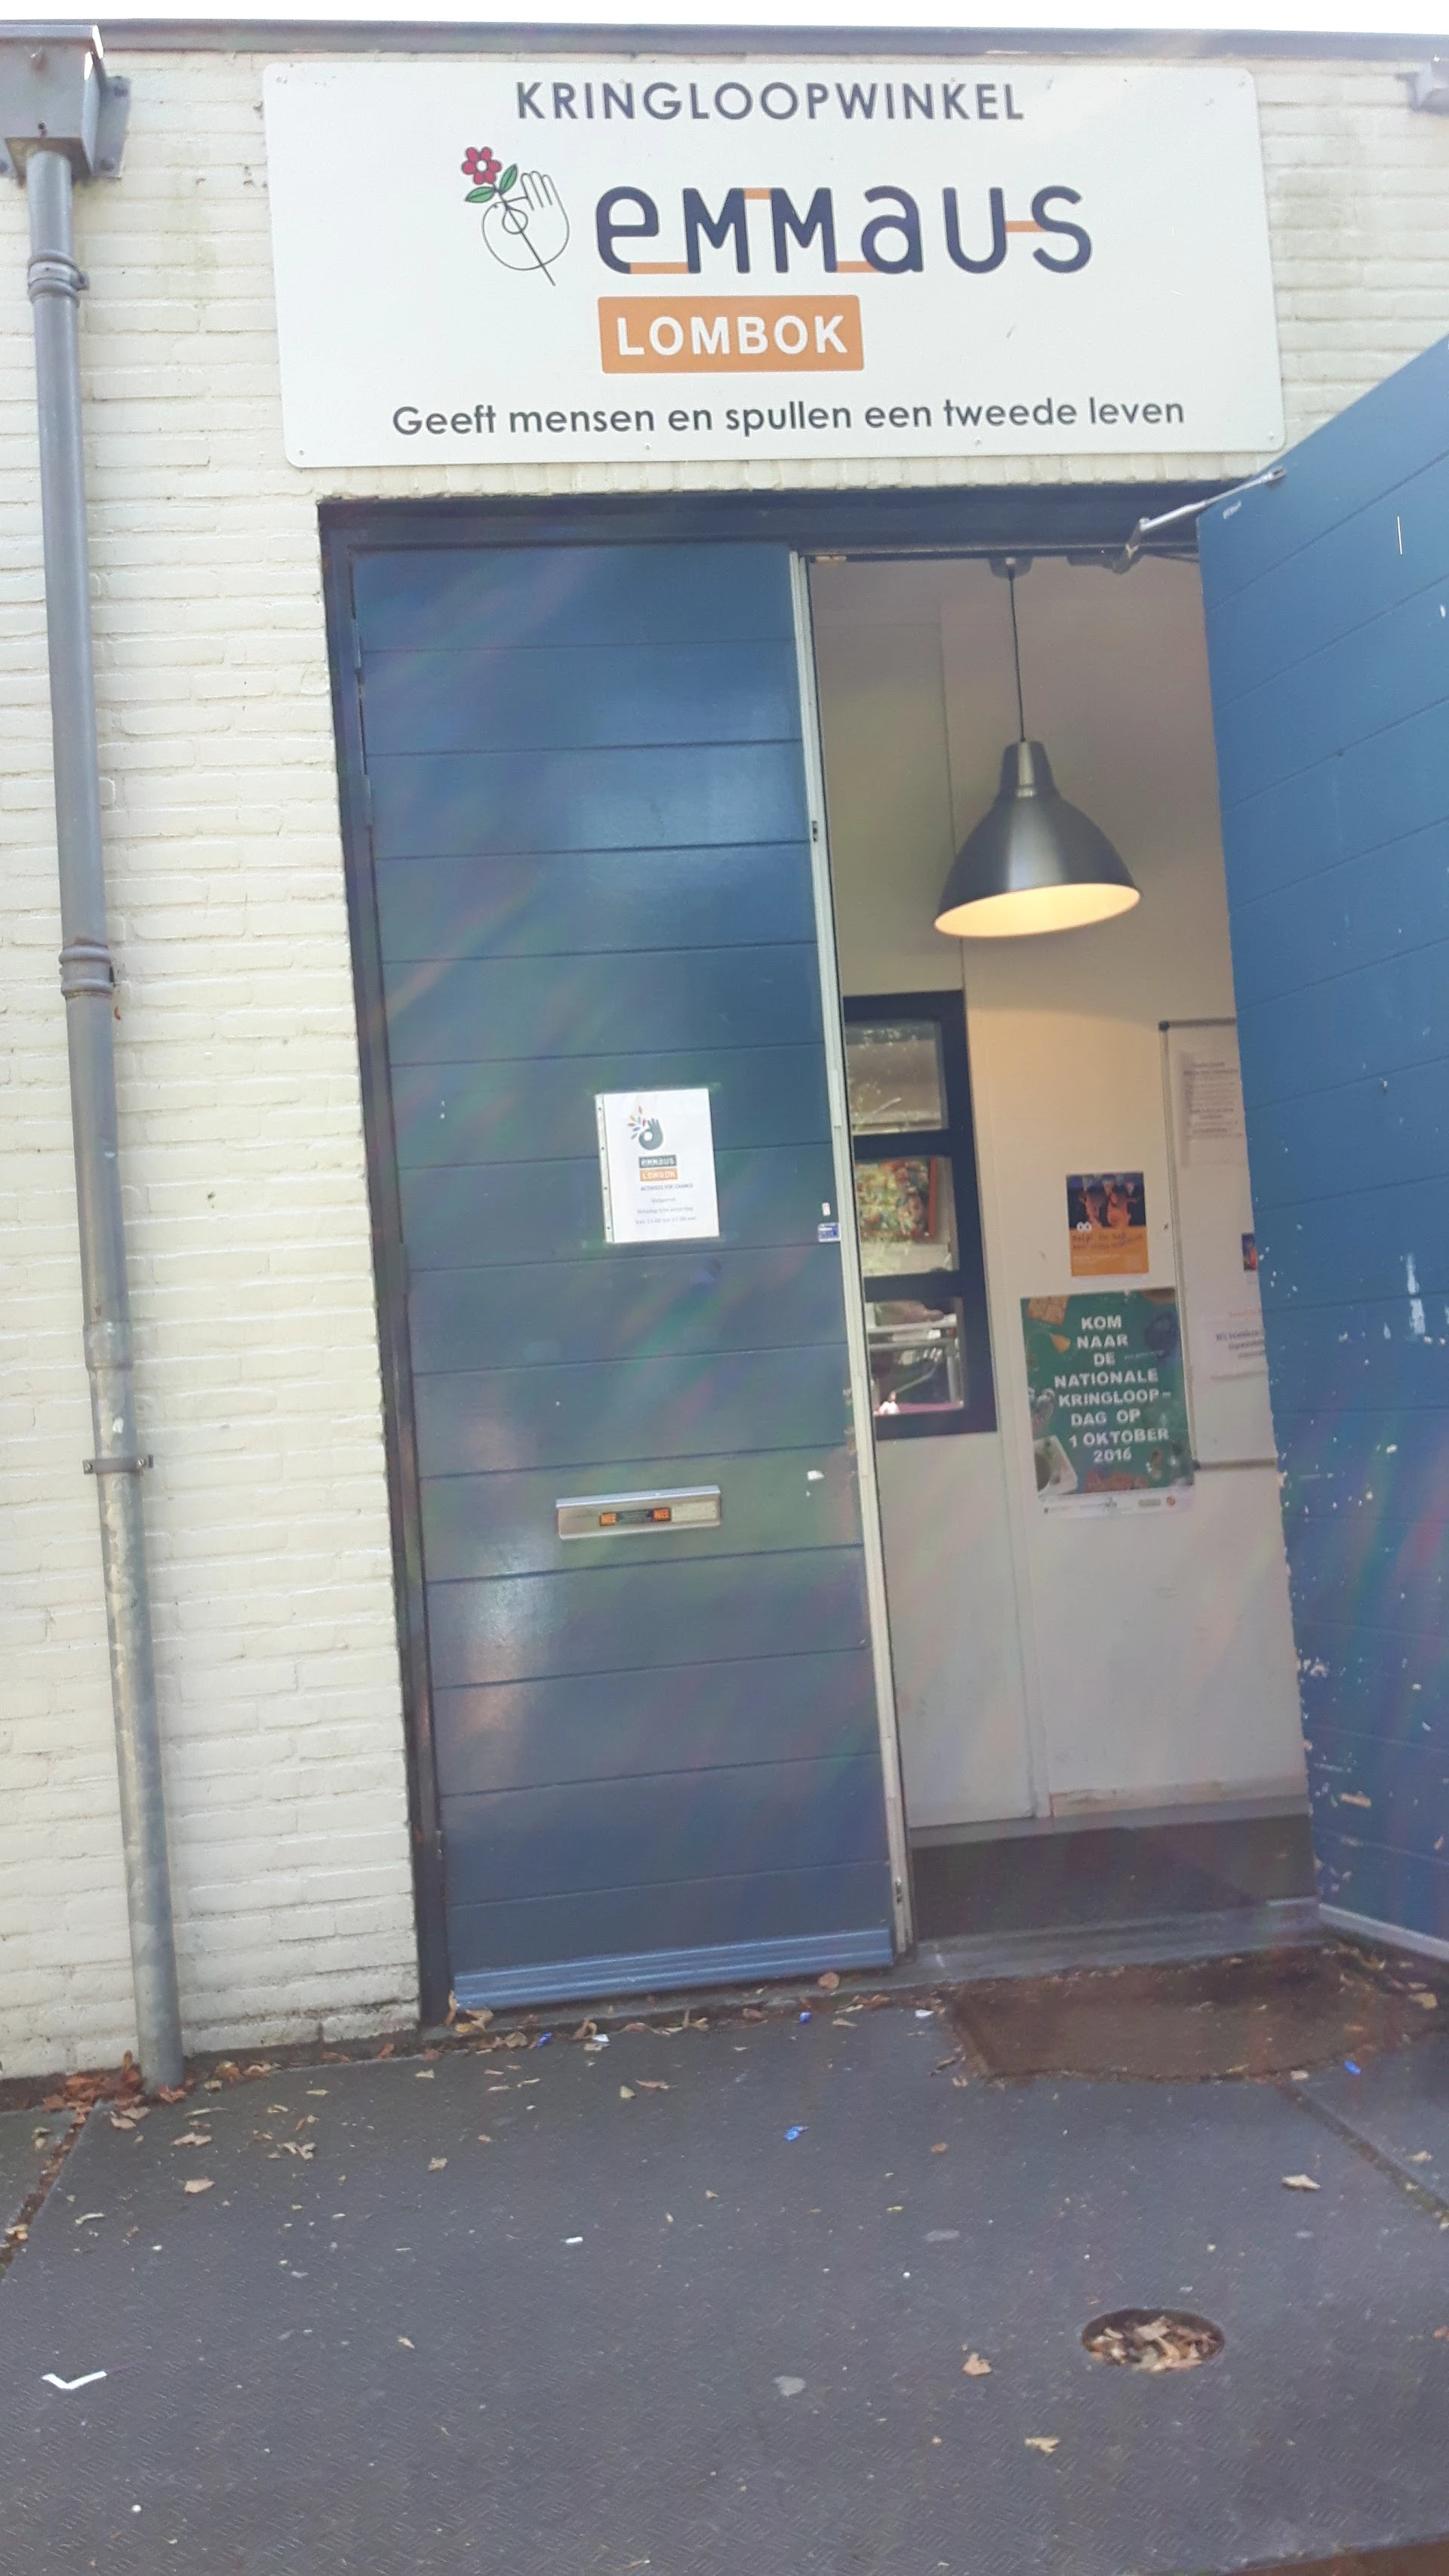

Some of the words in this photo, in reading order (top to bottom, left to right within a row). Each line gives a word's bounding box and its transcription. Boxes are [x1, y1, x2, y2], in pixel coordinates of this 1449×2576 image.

[518, 82, 1024, 121] KRINGLOOPWINKEL
[617, 315, 848, 356] LOMBOK
[392, 405, 497, 436] Geeft
[509, 410, 655, 434] mensen
[669, 410, 713, 432] en
[725, 401, 852, 439] spullen
[865, 406, 933, 429] een
[944, 398, 1078, 428] tweede
[1090, 397, 1185, 425] leven
[1081, 1316, 1122, 1331] KOM
[1076, 1334, 1129, 1350] NAAR
[1094, 1352, 1115, 1366] DE
[1054, 1368, 1159, 1388] NATIONALE
[1058, 1389, 1172, 1408] KRINGLOOP-
[1071, 1411, 1107, 1427] DAG
[1116, 1408, 1142, 1425] OP
[1069, 1435, 1078, 1448] 1
[1082, 1427, 1171, 1446] OKTOBER
[1093, 1448, 1133, 1464] 2016
